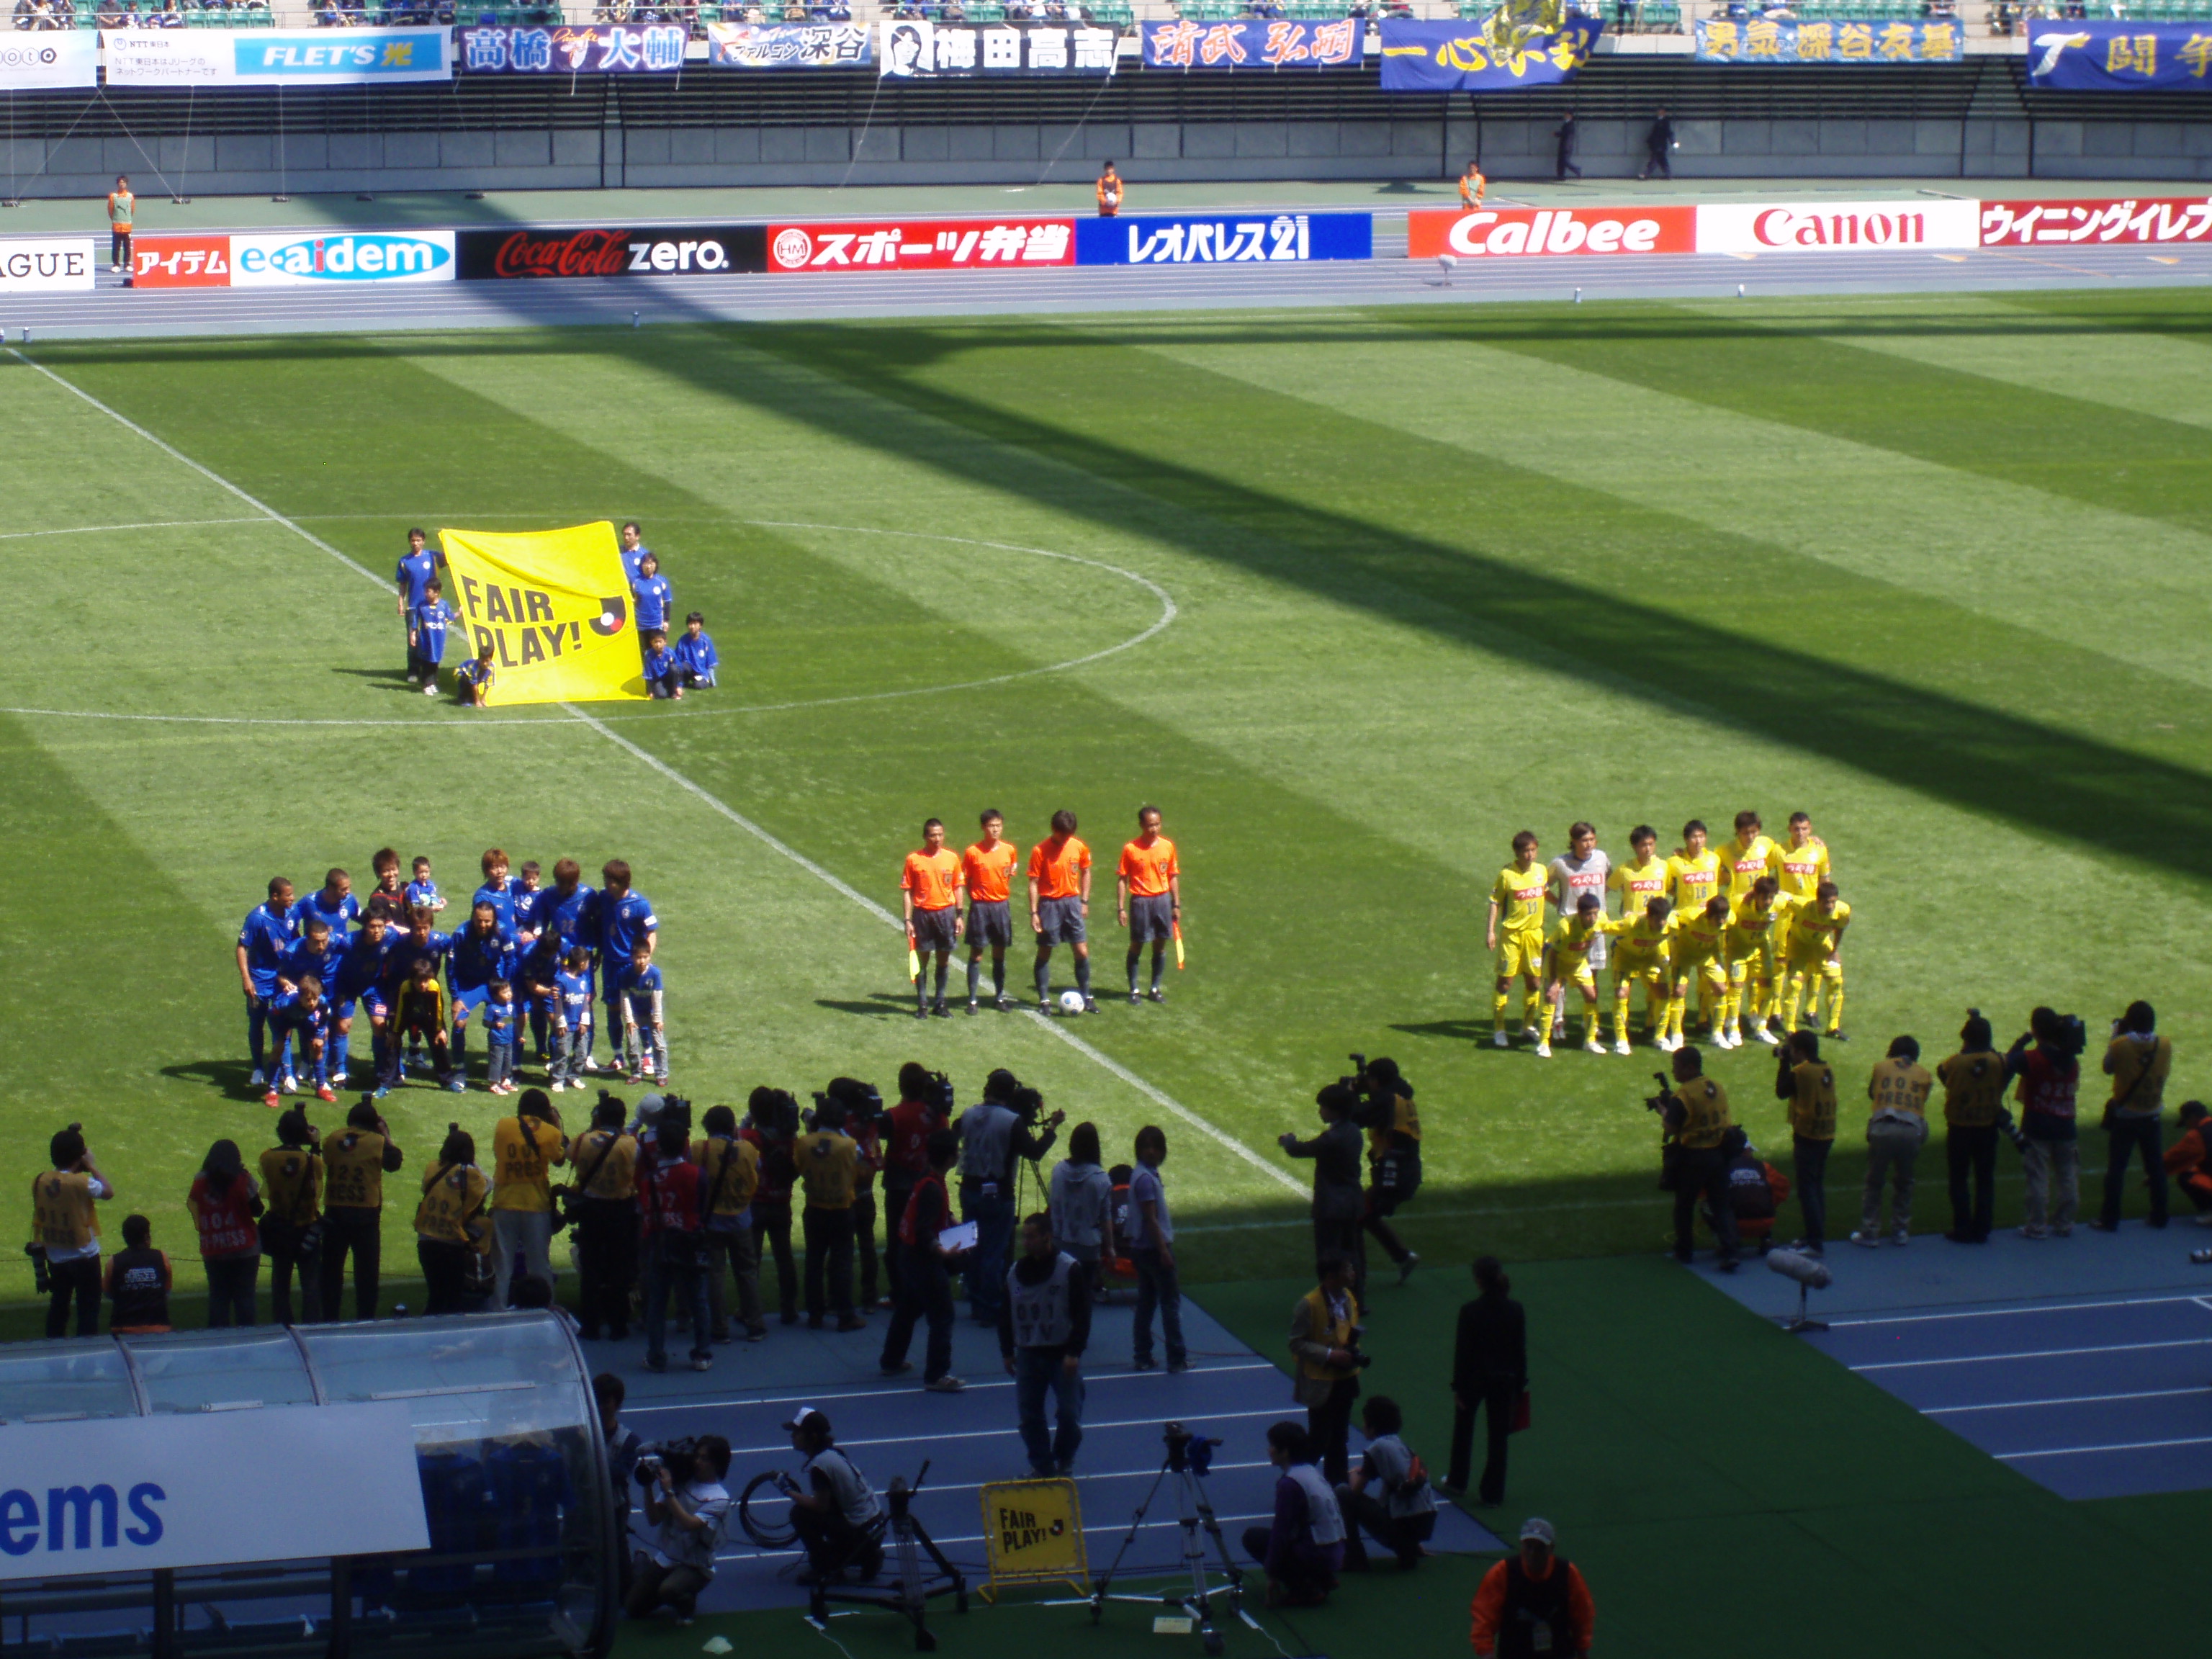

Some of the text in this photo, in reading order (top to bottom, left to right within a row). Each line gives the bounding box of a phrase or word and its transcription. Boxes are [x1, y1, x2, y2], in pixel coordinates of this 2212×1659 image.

[264, 43, 413, 66] FLET'S 光
[465, 29, 552, 70] 高橋
[598, 27, 685, 68] 大輔
[800, 27, 865, 59] 深谷
[809, 224, 1071, 266] スポーツ弁当
[1128, 215, 1310, 263] レオパレス21
[1449, 210, 1660, 256] Calbee
[1753, 209, 1924, 246] Canon
[136, 250, 229, 275] アイテム
[240, 237, 433, 273] e-aidem
[780, 243, 804, 254] HM
[461, 573, 554, 624] FAIR
[472, 621, 583, 668] PLAY!
[0, 1482, 166, 1556] ems
[999, 1507, 1035, 1529] FAIR
[1002, 1527, 1046, 1554] PLAY!
